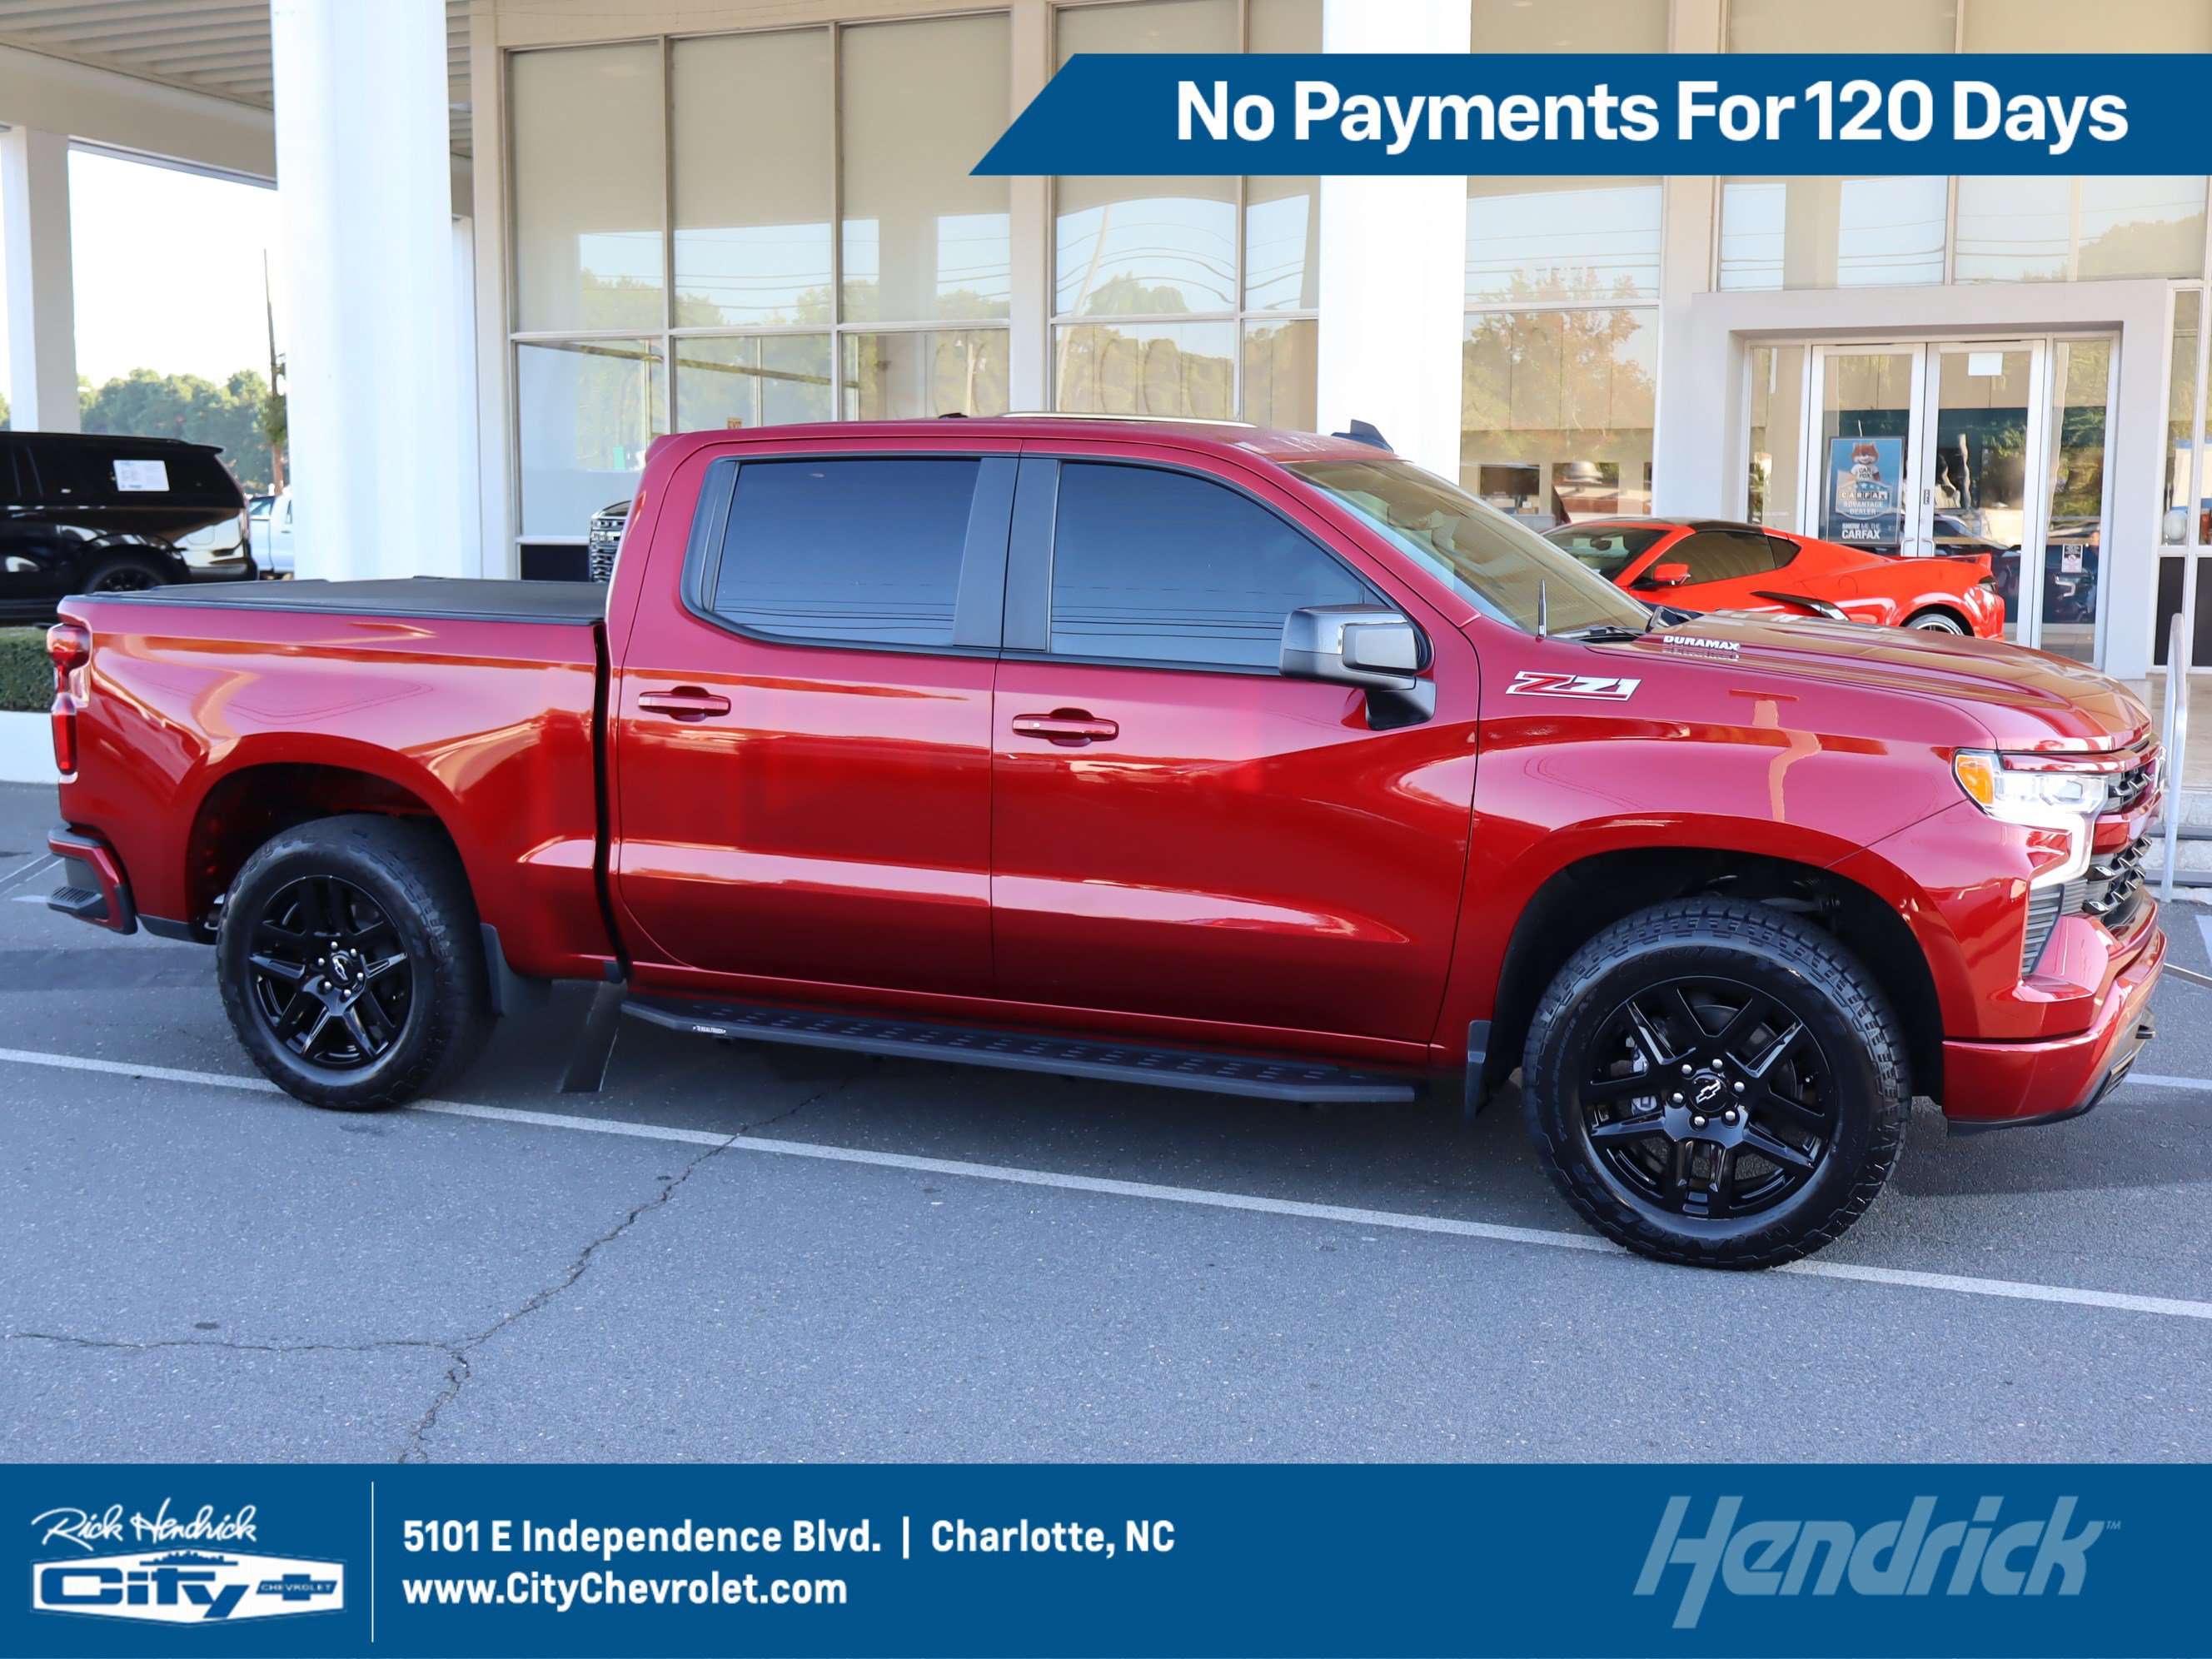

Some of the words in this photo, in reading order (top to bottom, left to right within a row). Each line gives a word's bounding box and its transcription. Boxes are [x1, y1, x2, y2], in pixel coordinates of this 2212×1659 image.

[1841, 491, 1887, 500] CARFAX
[1841, 530, 1881, 540] CARFAX
[1663, 635, 1739, 651] DURAMAX
[1506, 670, 1642, 701] Z71
